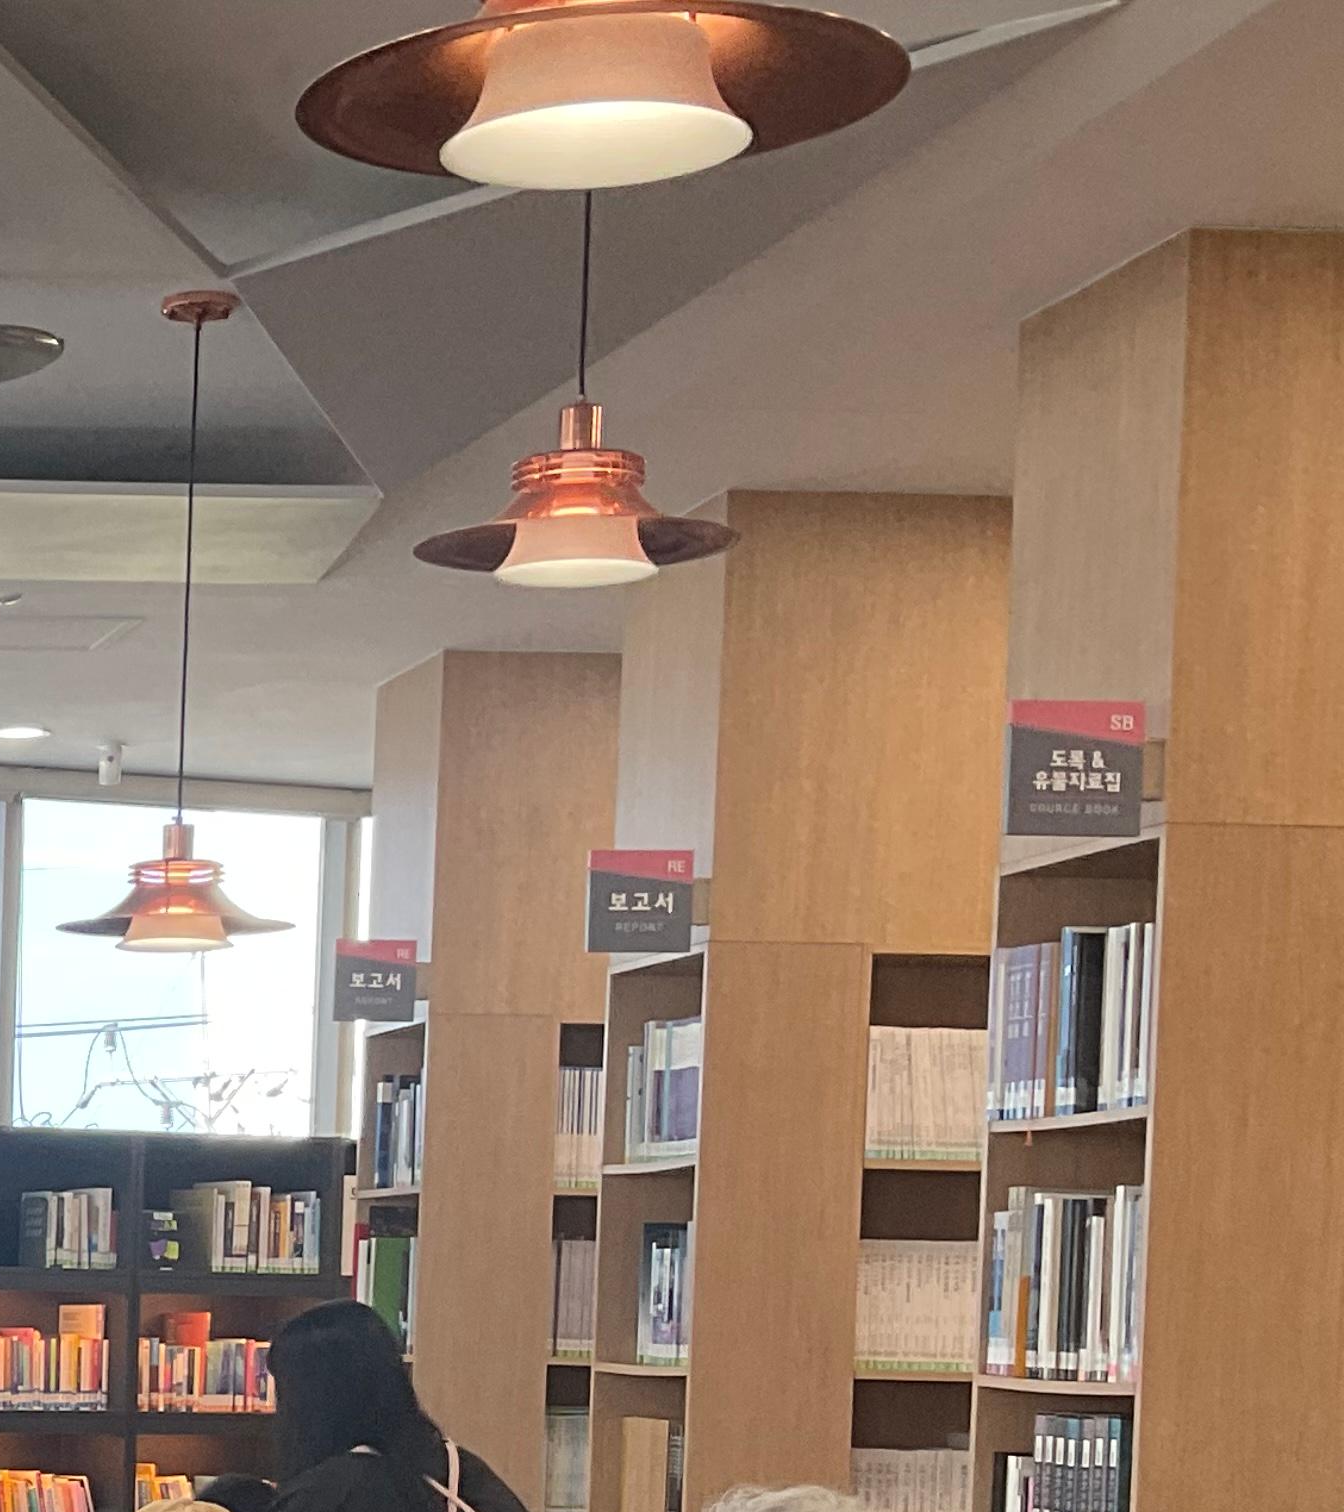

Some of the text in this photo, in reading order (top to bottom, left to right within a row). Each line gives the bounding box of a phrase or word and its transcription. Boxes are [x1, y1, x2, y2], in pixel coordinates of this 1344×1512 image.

[1110, 714, 1134, 731] SB
[1050, 750, 1109, 770] 도록 &
[667, 860, 686, 873] RE
[608, 892, 674, 914] 보고서
[349, 972, 401, 991] 보고서
